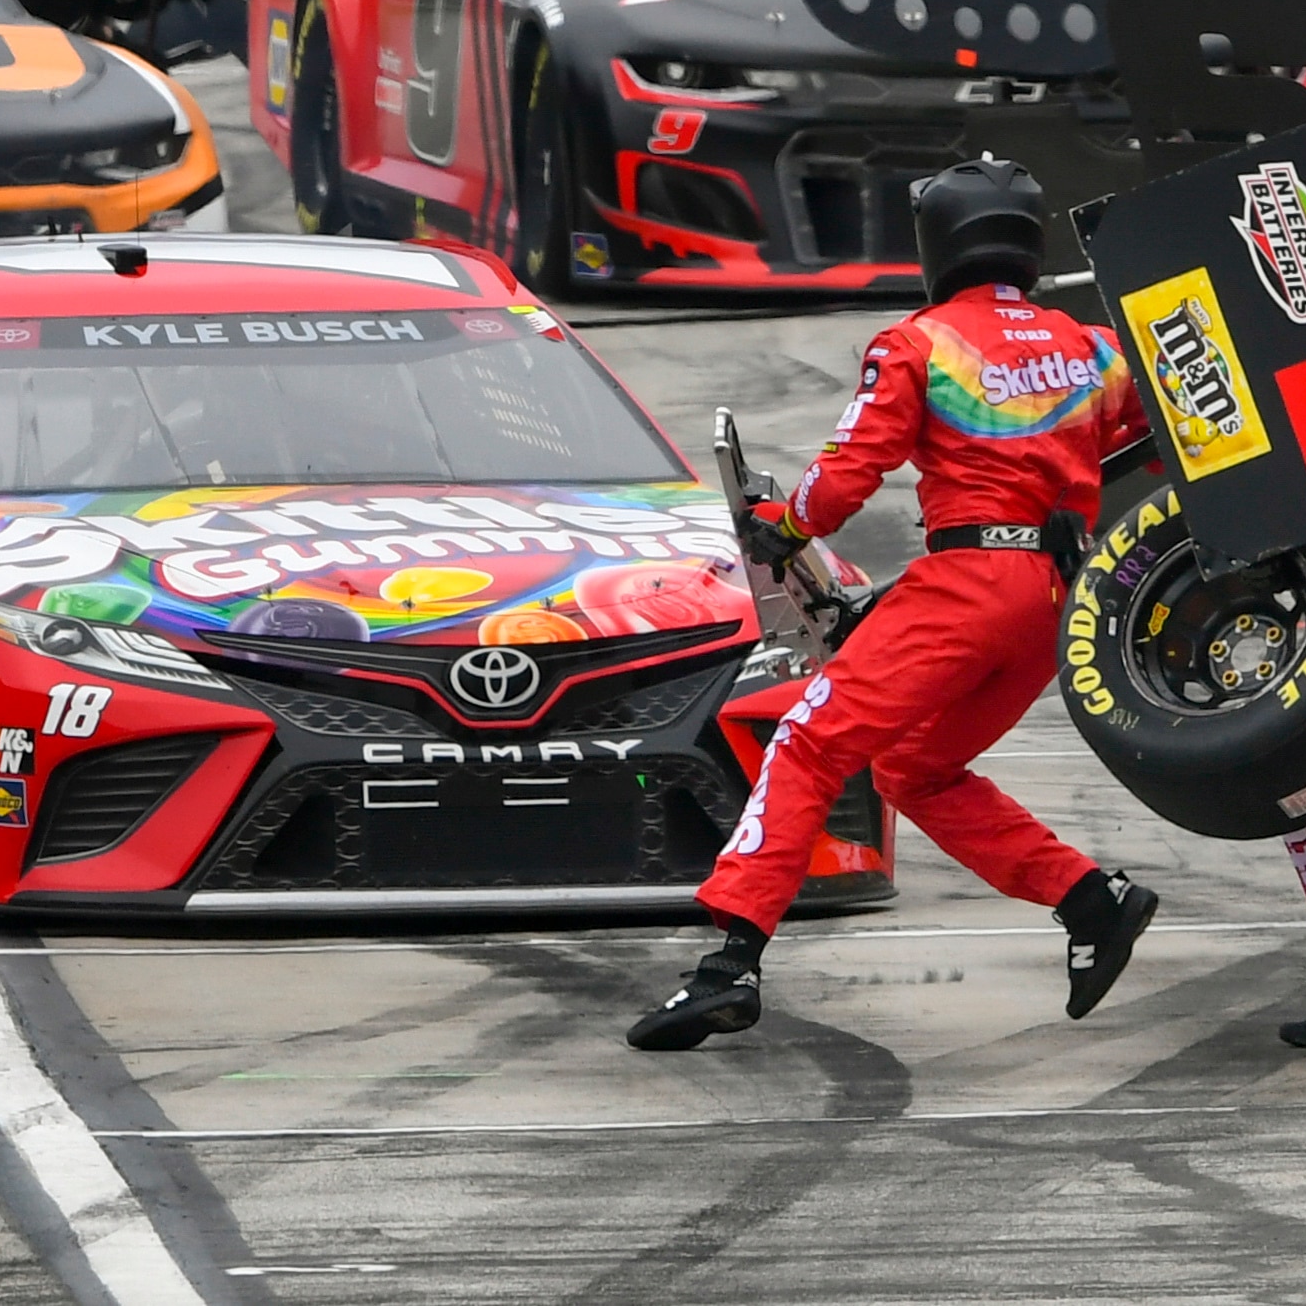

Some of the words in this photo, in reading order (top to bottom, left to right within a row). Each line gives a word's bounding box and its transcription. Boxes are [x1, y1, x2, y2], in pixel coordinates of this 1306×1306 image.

[648, 108, 707, 154] 9
[83, 324, 241, 347] KYLE
[248, 319, 424, 344] BUSCH
[1002, 329, 1053, 342] FORD
[980, 351, 1105, 406] Skittles
[161, 528, 742, 597] Gummie
[41, 682, 113, 739] 18
[363, 739, 644, 764] CAMRY
